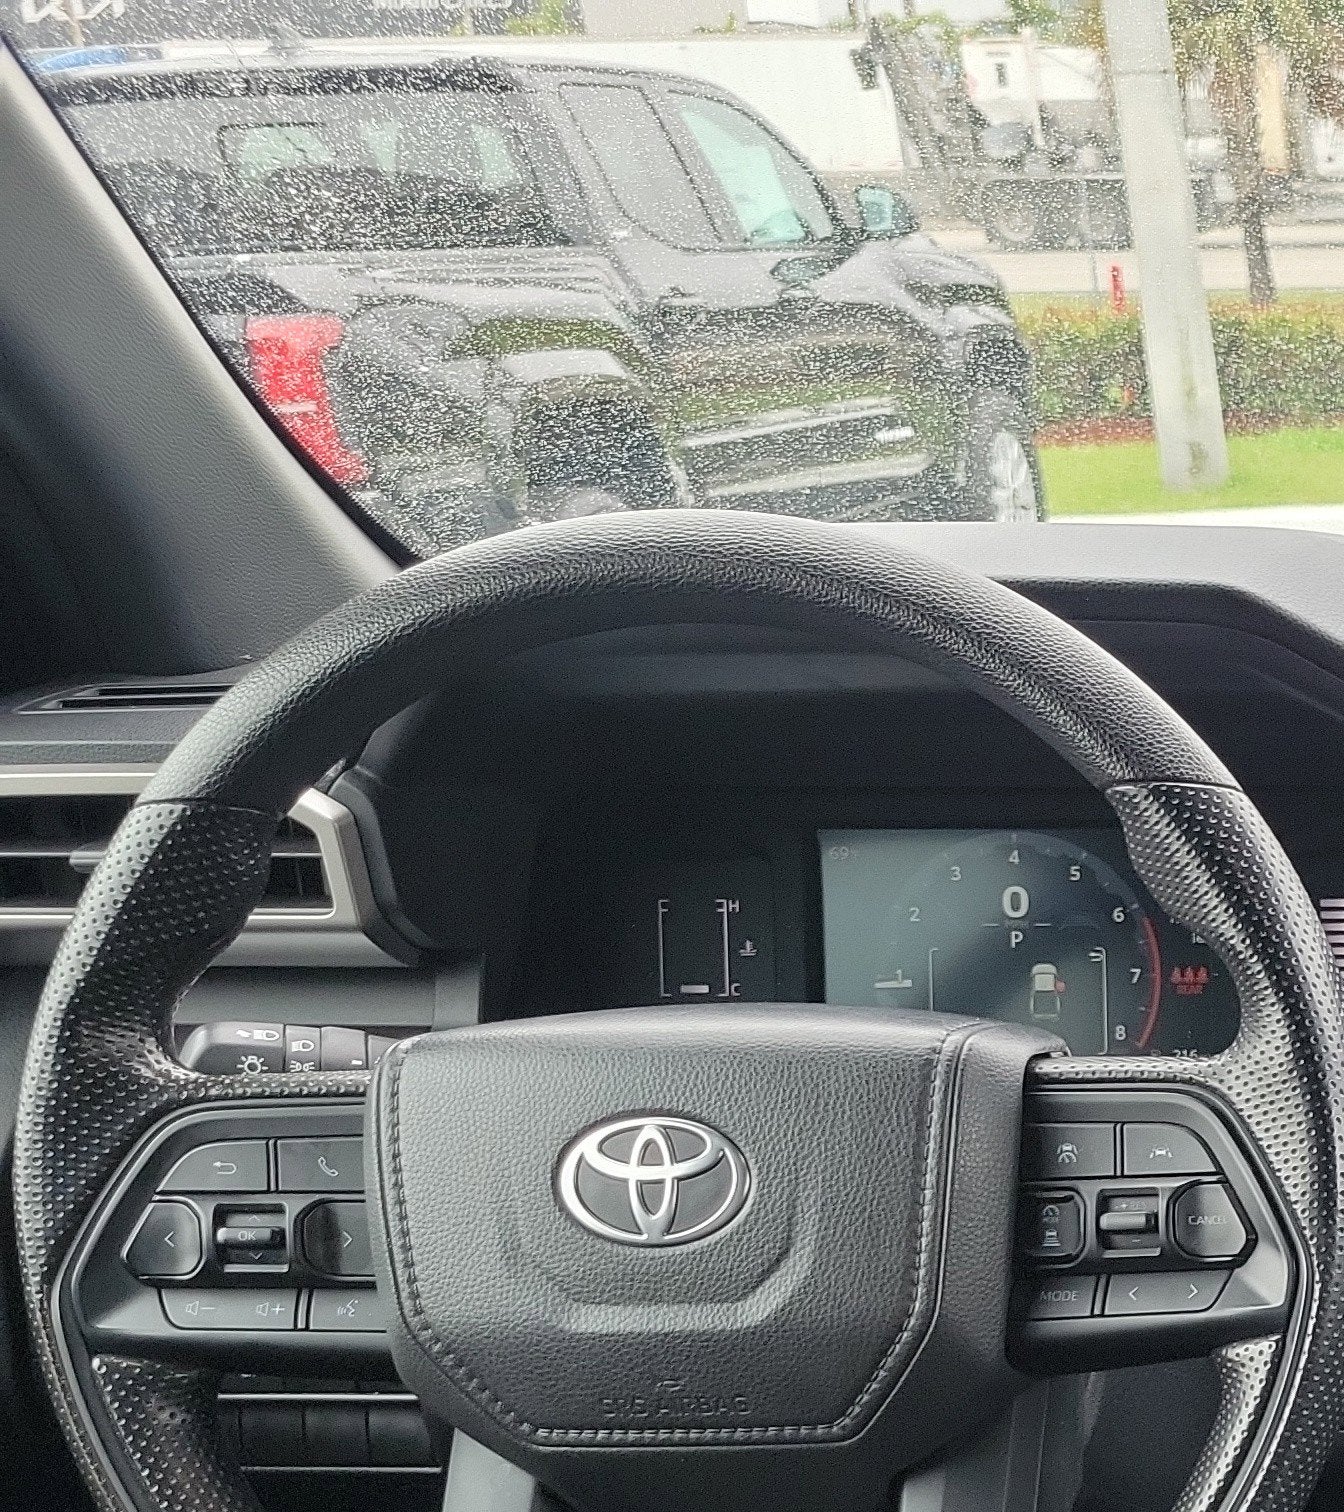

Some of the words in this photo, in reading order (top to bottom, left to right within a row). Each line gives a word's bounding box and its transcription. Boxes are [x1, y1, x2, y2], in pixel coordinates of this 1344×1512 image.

[1008, 849, 1020, 865] 4
[950, 865, 962, 881] 3
[1068, 865, 1081, 881] 5
[728, 899, 740, 913] H
[1001, 885, 1031, 918] 0
[909, 907, 921, 922] 2
[1112, 906, 1125, 923] 6
[1010, 931, 1024, 948] P
[1129, 968, 1142, 984] 7
[730, 982, 741, 997] C
[1115, 1024, 1127, 1041] 8
[237, 1230, 257, 1241] OK
[1040, 1290, 1078, 1301] MODE
